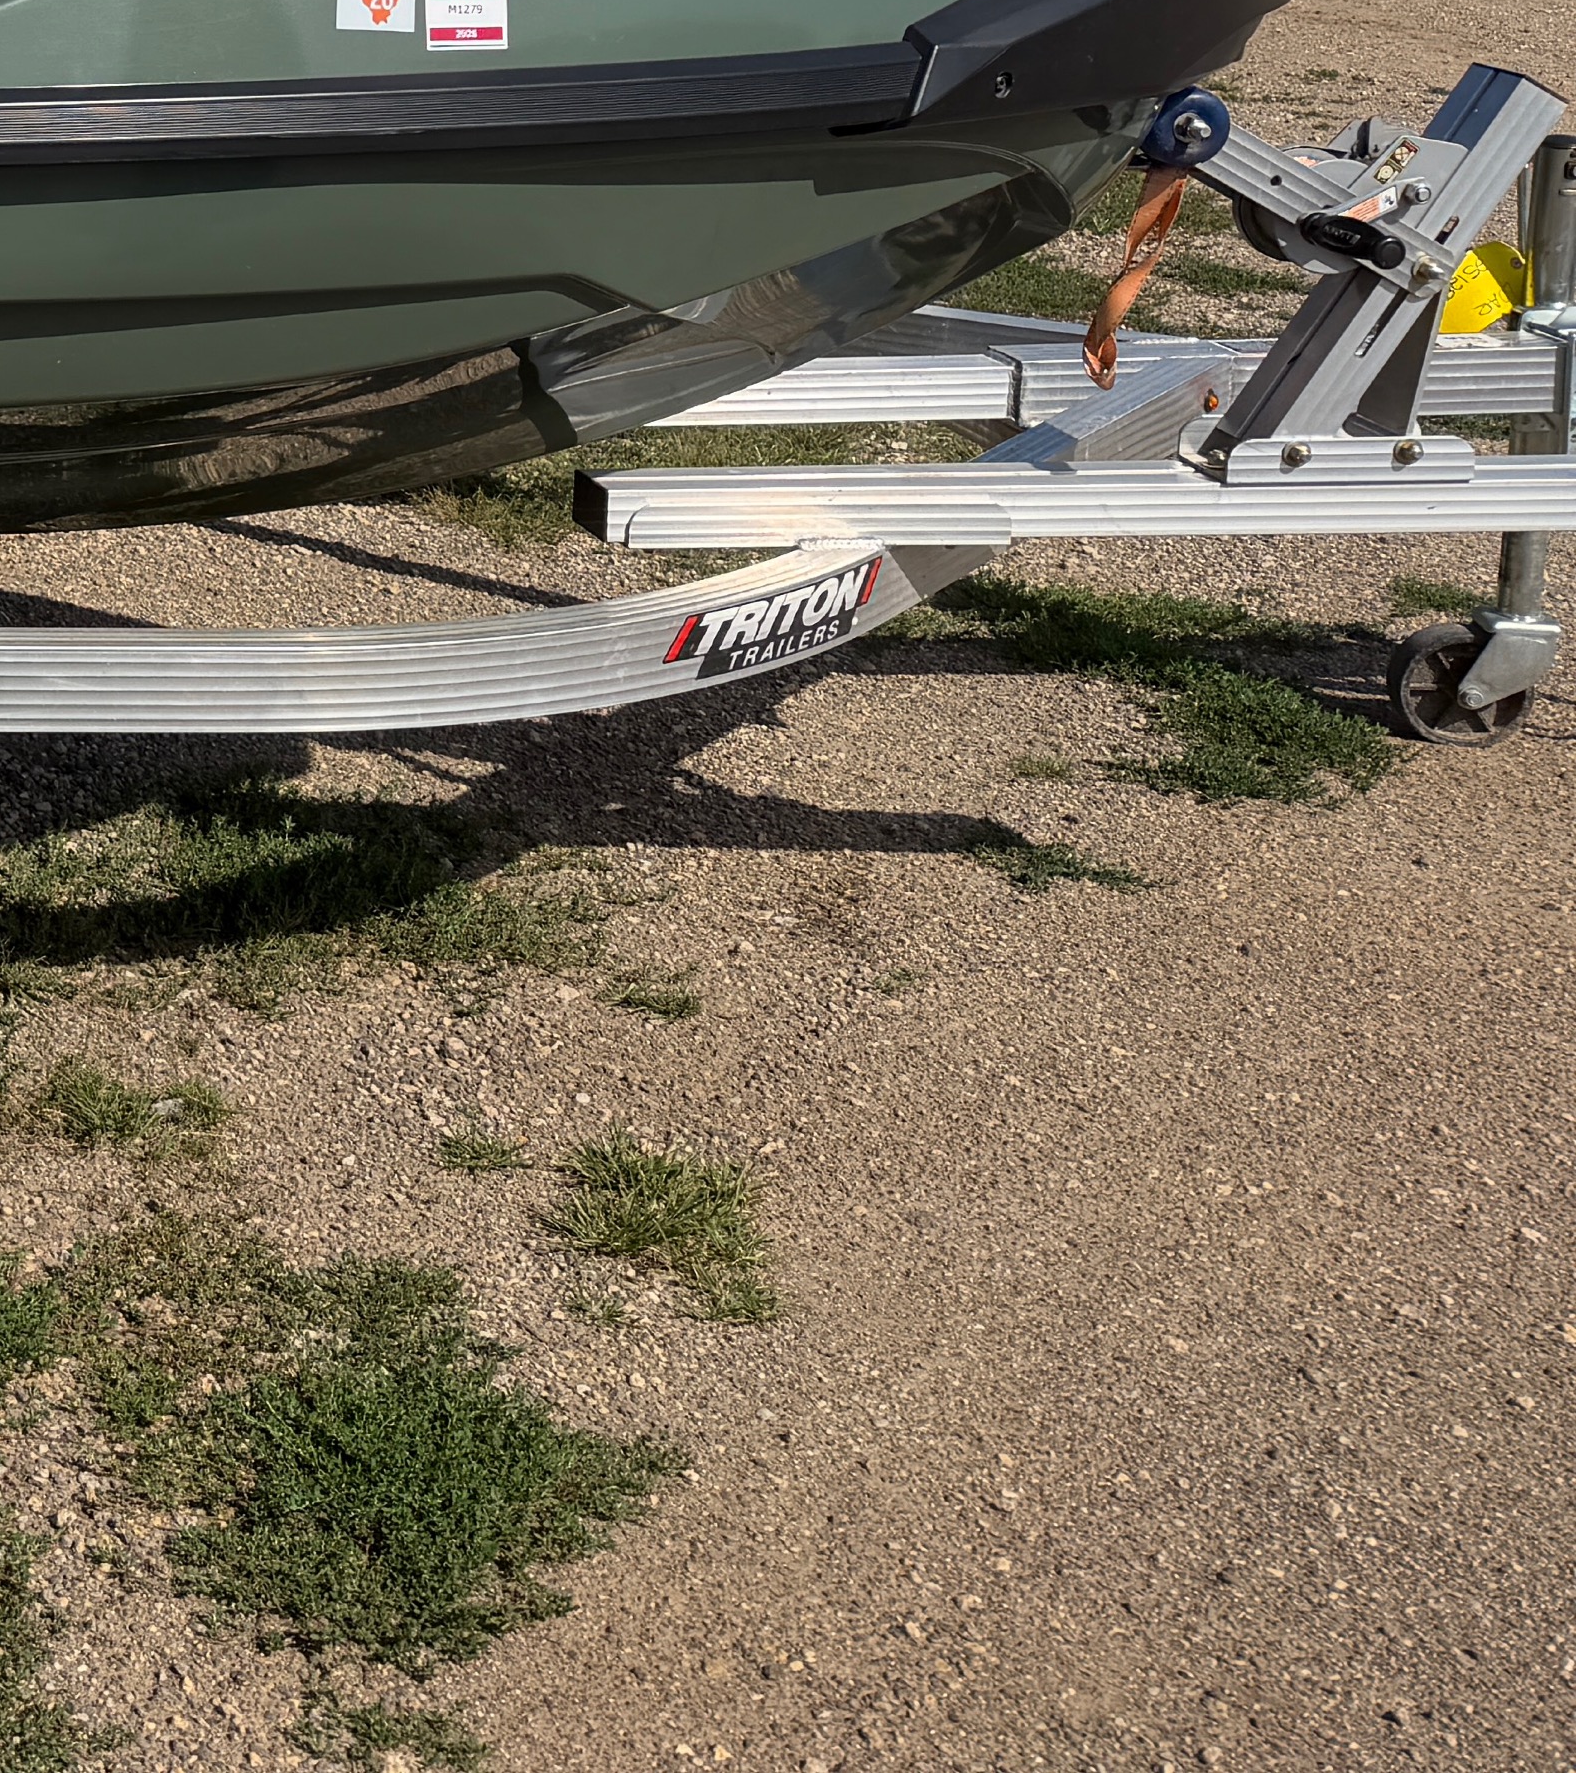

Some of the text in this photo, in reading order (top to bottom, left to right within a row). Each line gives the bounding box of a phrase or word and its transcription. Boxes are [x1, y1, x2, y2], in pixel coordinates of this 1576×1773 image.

[448, 4, 483, 14] M1279
[694, 563, 869, 656] TRITON
[728, 620, 839, 670] TRAILERS
